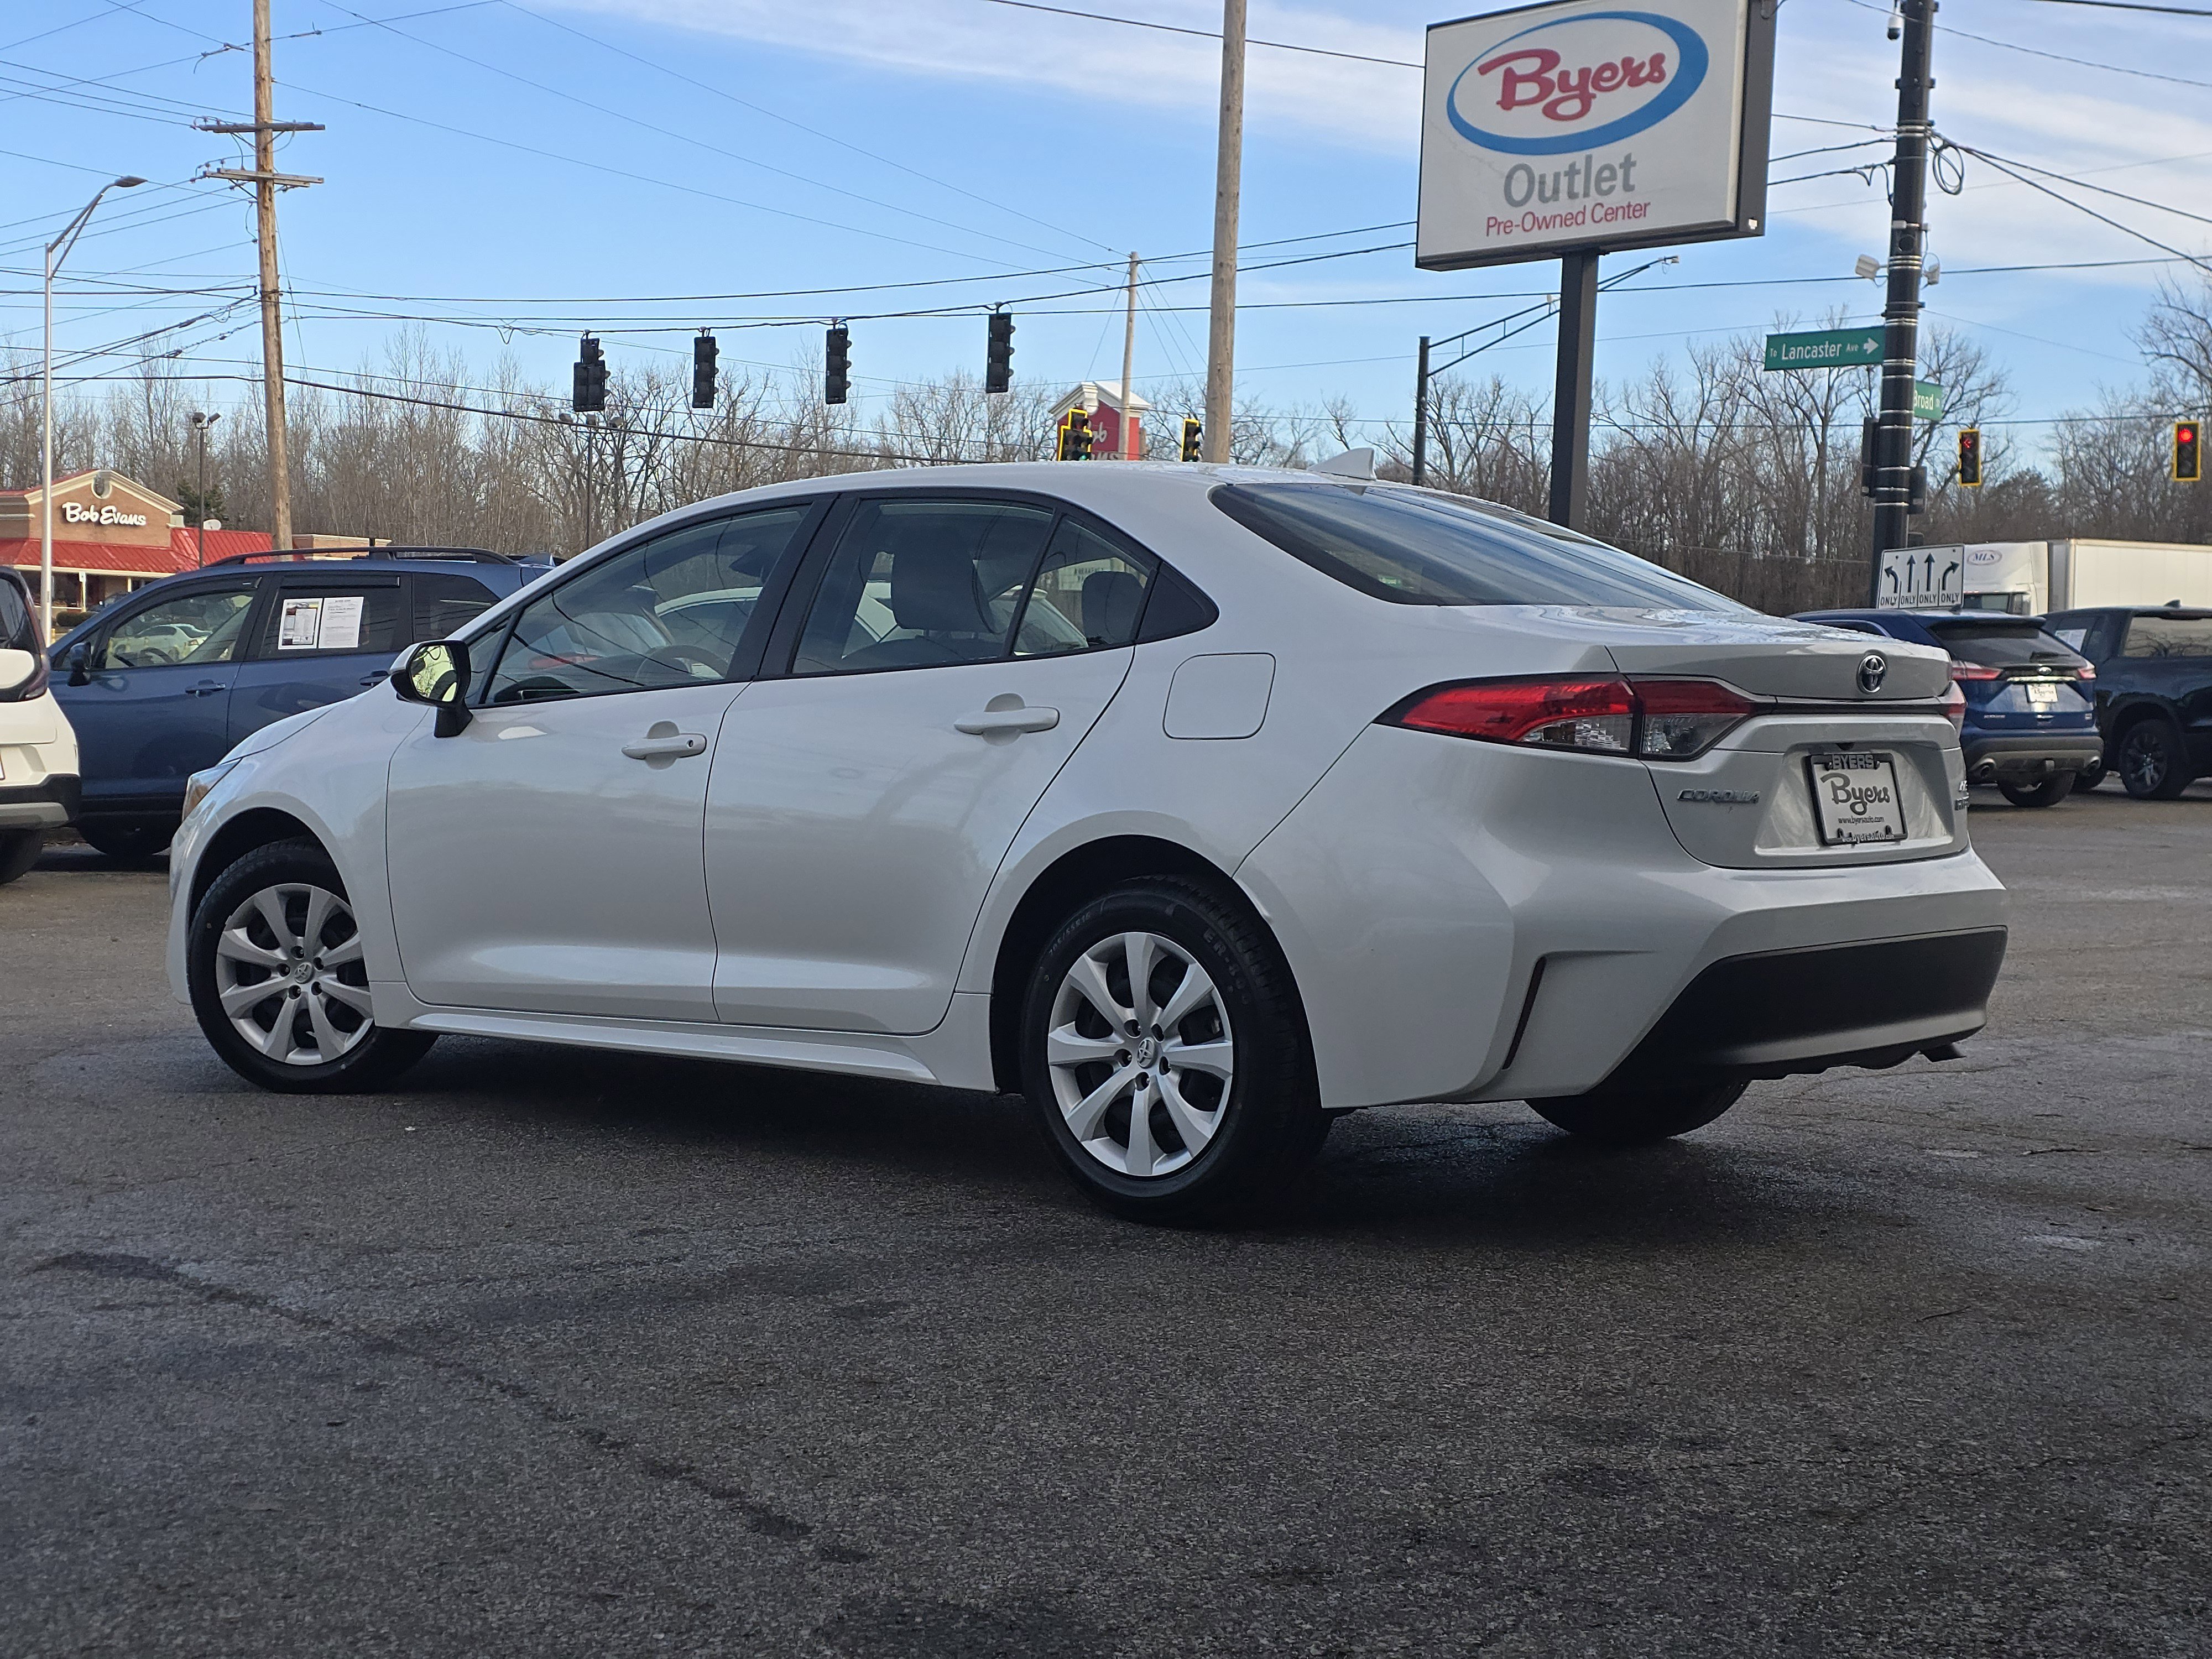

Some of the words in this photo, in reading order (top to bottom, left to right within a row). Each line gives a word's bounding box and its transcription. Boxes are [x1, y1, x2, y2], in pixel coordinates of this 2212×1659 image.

[1477, 48, 1666, 121] Byers
[1503, 153, 1637, 208] Outlet
[1486, 205, 1587, 237] Pre-Owned
[1591, 201, 1651, 223] Center
[1770, 348, 1778, 358] To
[1782, 340, 1843, 361] Lancaster
[1846, 343, 1859, 352] Ave
[1913, 389, 1934, 410] Broad
[62, 502, 99, 523] Bob
[100, 505, 147, 526] Evans
[1971, 552, 1995, 561] MLS
[1880, 596, 1898, 606] ONLY
[1900, 595, 1917, 605] ONLY
[1919, 593, 1937, 604] ONLY
[1940, 592, 1960, 604] ONLY
[1832, 754, 1875, 770] BYERS
[1677, 789, 1761, 803] COROLLA
[1820, 772, 1891, 816] Byers
